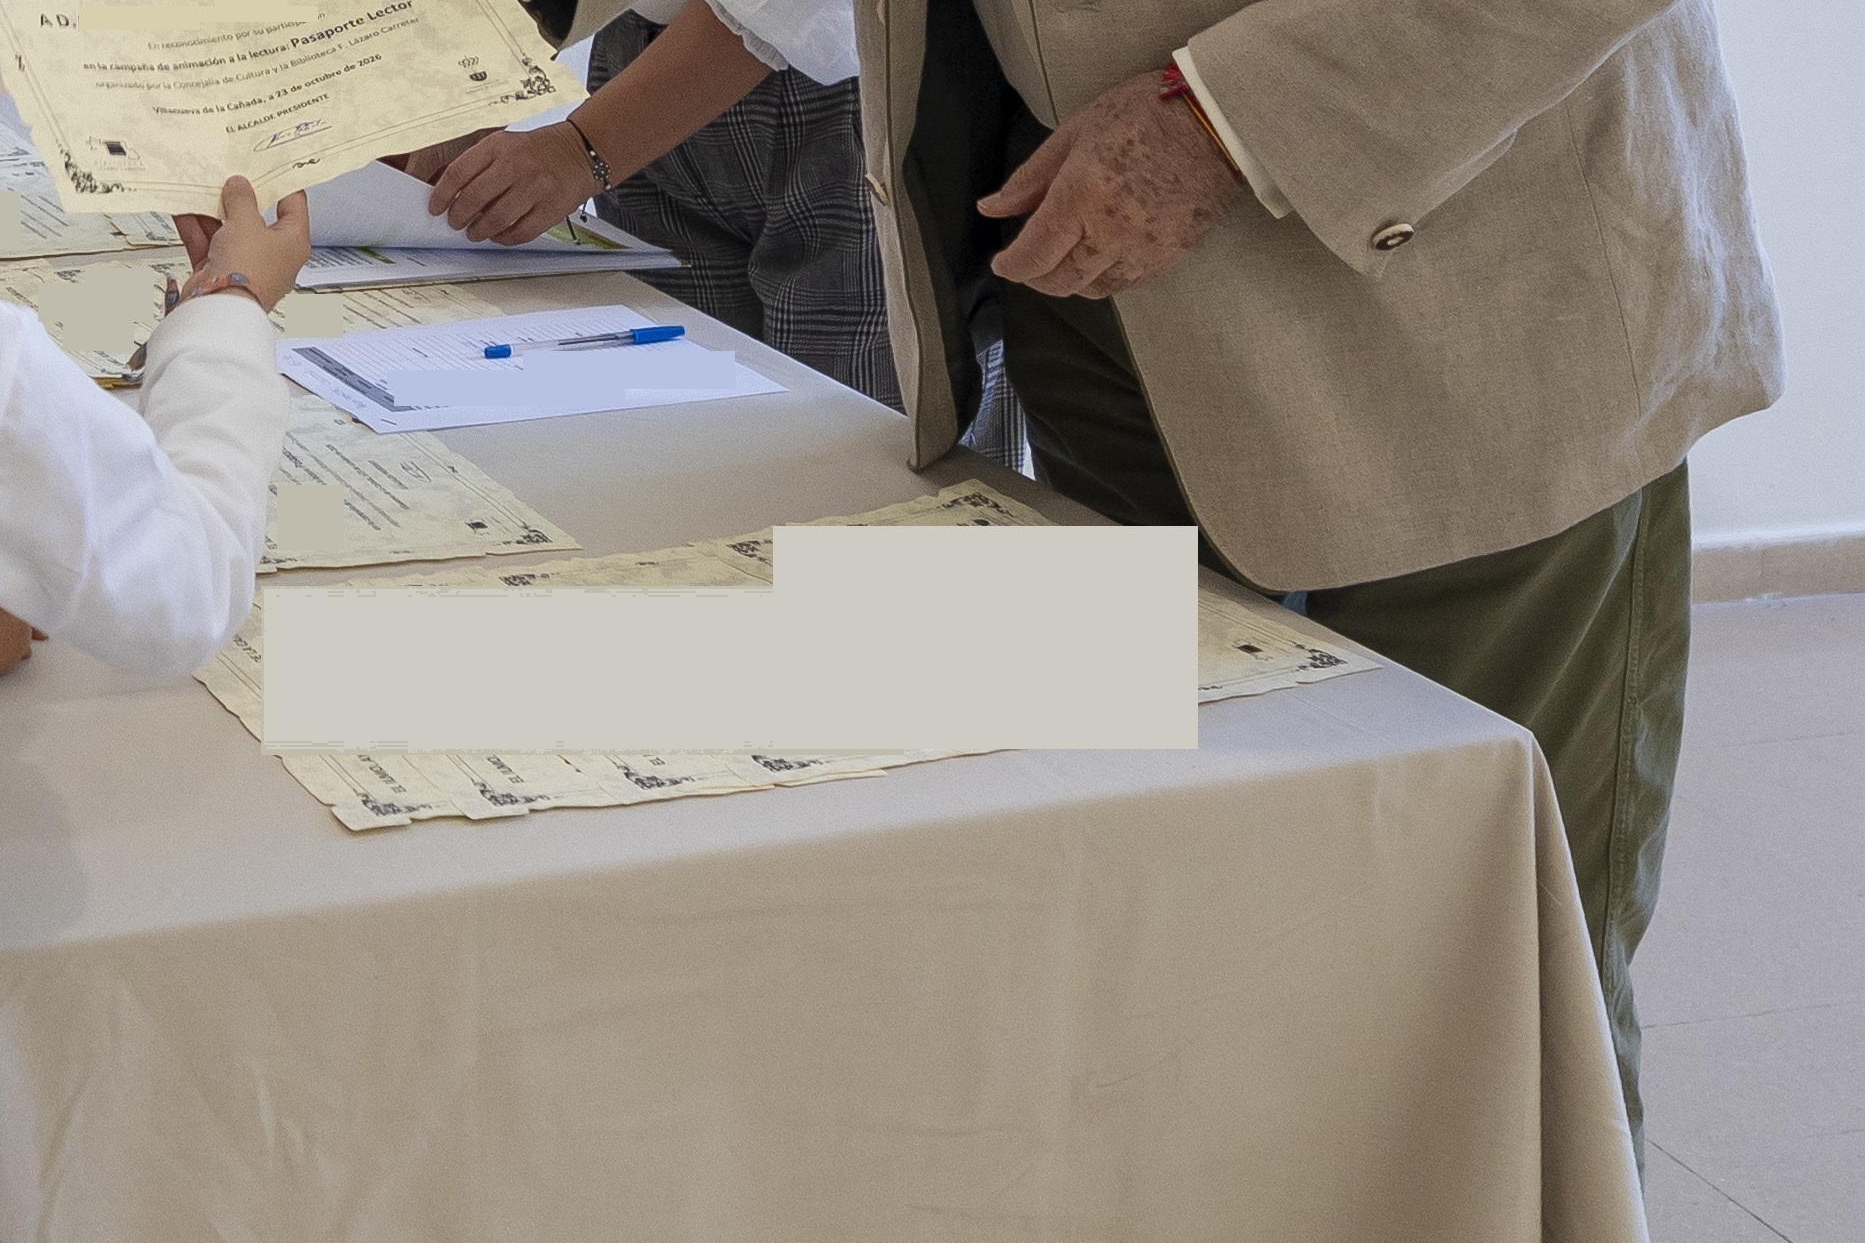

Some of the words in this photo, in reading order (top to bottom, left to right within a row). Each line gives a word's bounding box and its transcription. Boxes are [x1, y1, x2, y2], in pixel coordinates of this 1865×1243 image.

[40, 13, 53, 28] A
[157, 62, 170, 71] de
[173, 57, 226, 70] animación
[237, 53, 247, 62] la
[290, 16, 366, 48] Pasaporte
[367, 0, 413, 21] Lector
[161, 33, 234, 49] reconocimiento
[235, 30, 251, 41] por
[253, 27, 265, 37] su
[222, 75, 234, 84] de
[235, 68, 270, 82] Cultura
[271, 66, 279, 75] y
[279, 62, 290, 70] la
[290, 47, 337, 68] Biblioteca
[348, 30, 380, 46] Lázaro
[152, 106, 201, 115] Villanueva
[202, 105, 214, 114] de
[215, 103, 225, 112] la
[226, 97, 267, 111] Cañada,
[275, 88, 289, 99] 23
[290, 83, 303, 93] de
[304, 69, 342, 88] octubre
[343, 63, 356, 73] de
[357, 53, 382, 68] 2026
[225, 125, 236, 134] EL
[237, 113, 275, 132] ALCALDE
[276, 93, 330, 118] PRESIDENTE
